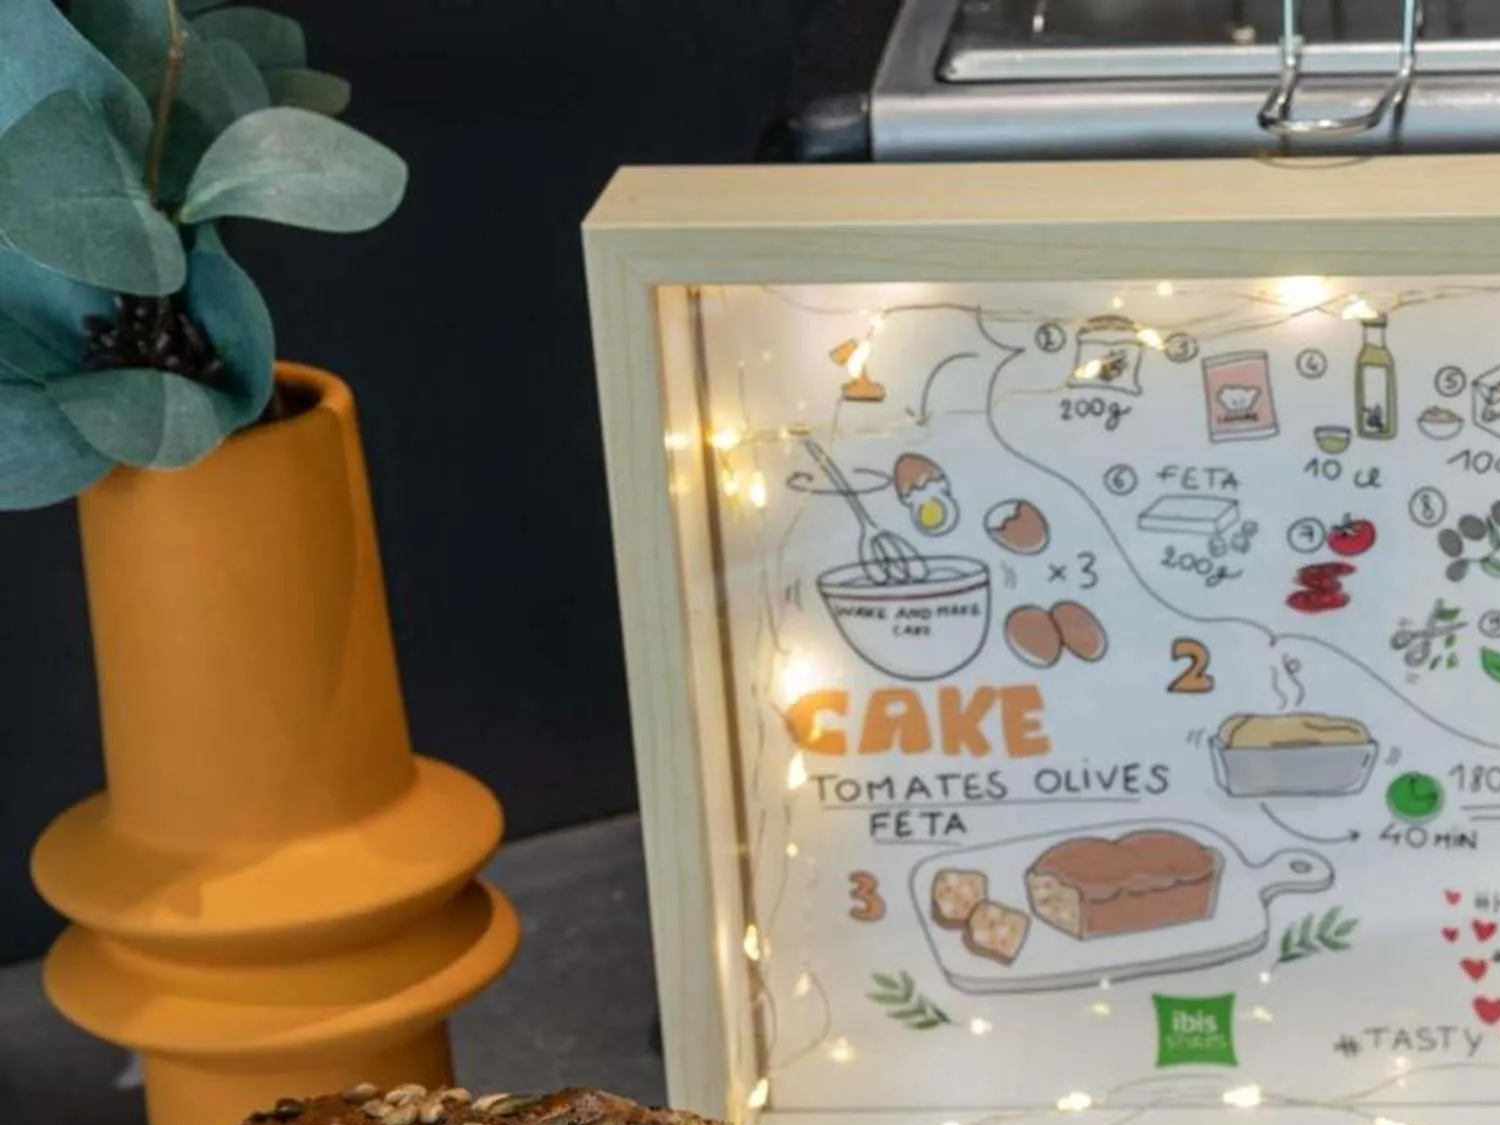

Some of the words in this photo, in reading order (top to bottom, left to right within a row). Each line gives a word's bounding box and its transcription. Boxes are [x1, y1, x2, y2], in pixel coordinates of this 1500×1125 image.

[1156, 463, 1240, 491] FETA
[1303, 457, 1343, 481] 10
[1166, 636, 1216, 694] 2
[784, 684, 1052, 759] CAKE
[811, 769, 1009, 801] TOMATES
[869, 810, 968, 838] FETA
[1379, 822, 1429, 849] 40
[847, 870, 888, 922] 3
[1171, 1009, 1219, 1034] ibis
[1332, 1023, 1484, 1058] #TASTY
